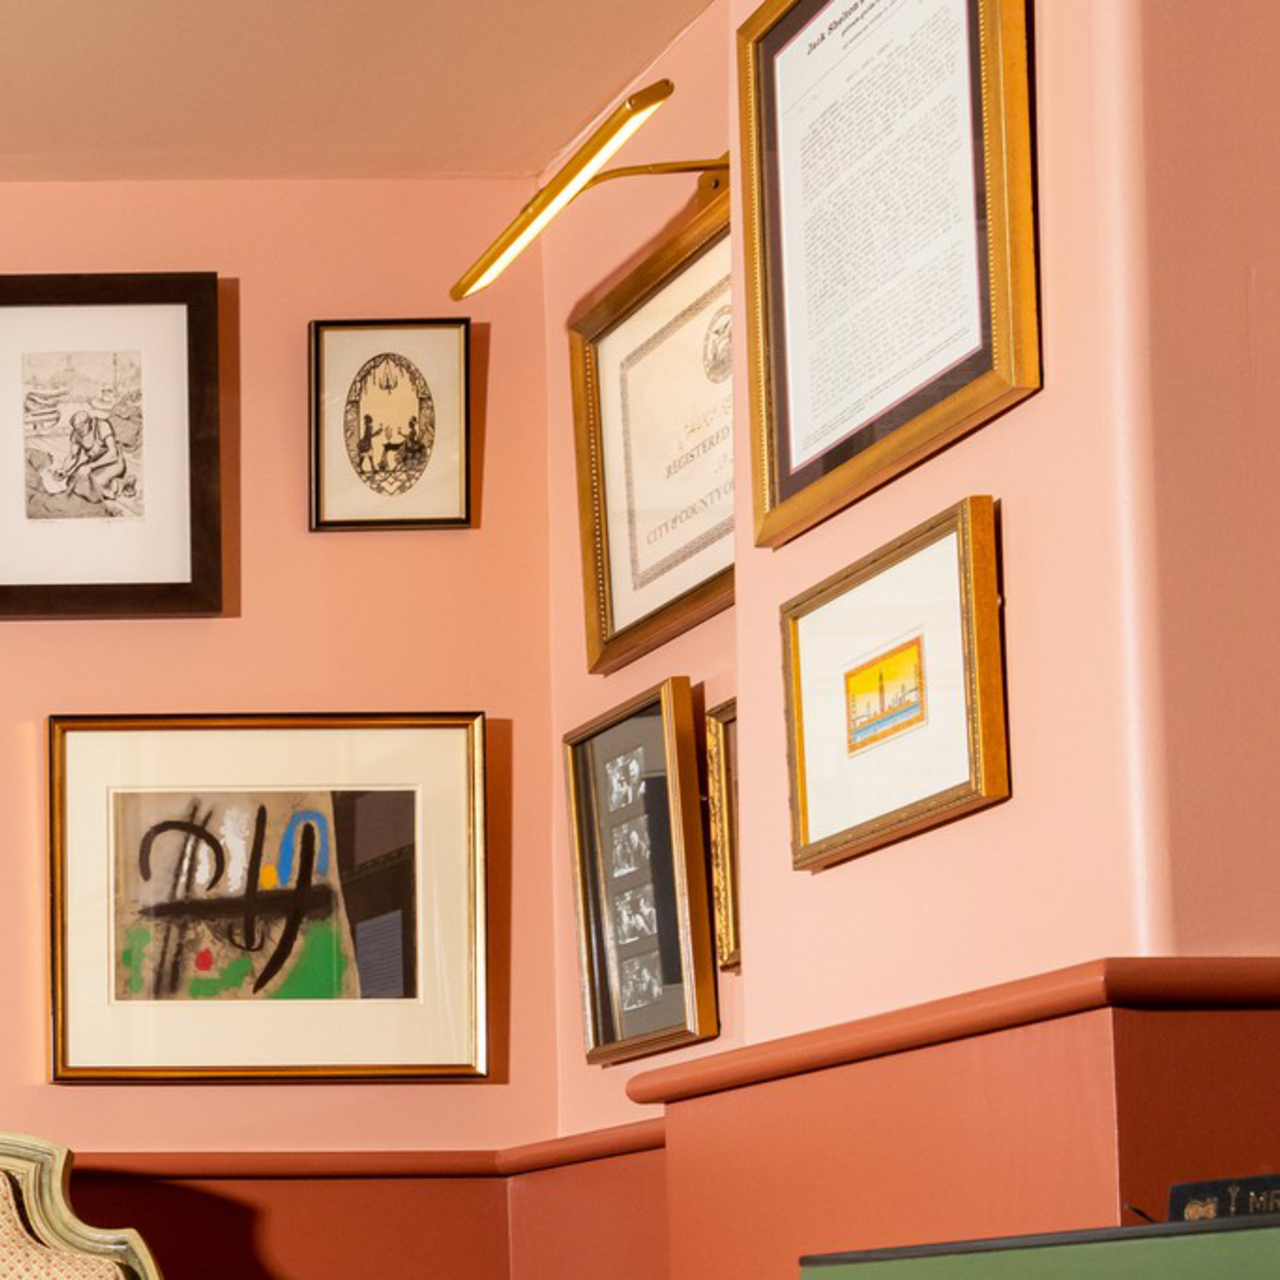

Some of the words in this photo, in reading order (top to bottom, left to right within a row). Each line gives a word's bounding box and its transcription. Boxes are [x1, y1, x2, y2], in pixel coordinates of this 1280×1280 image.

[665, 425, 731, 479] REGISTERED
[646, 520, 669, 546] CITY
[678, 486, 724, 525] COUNTY
